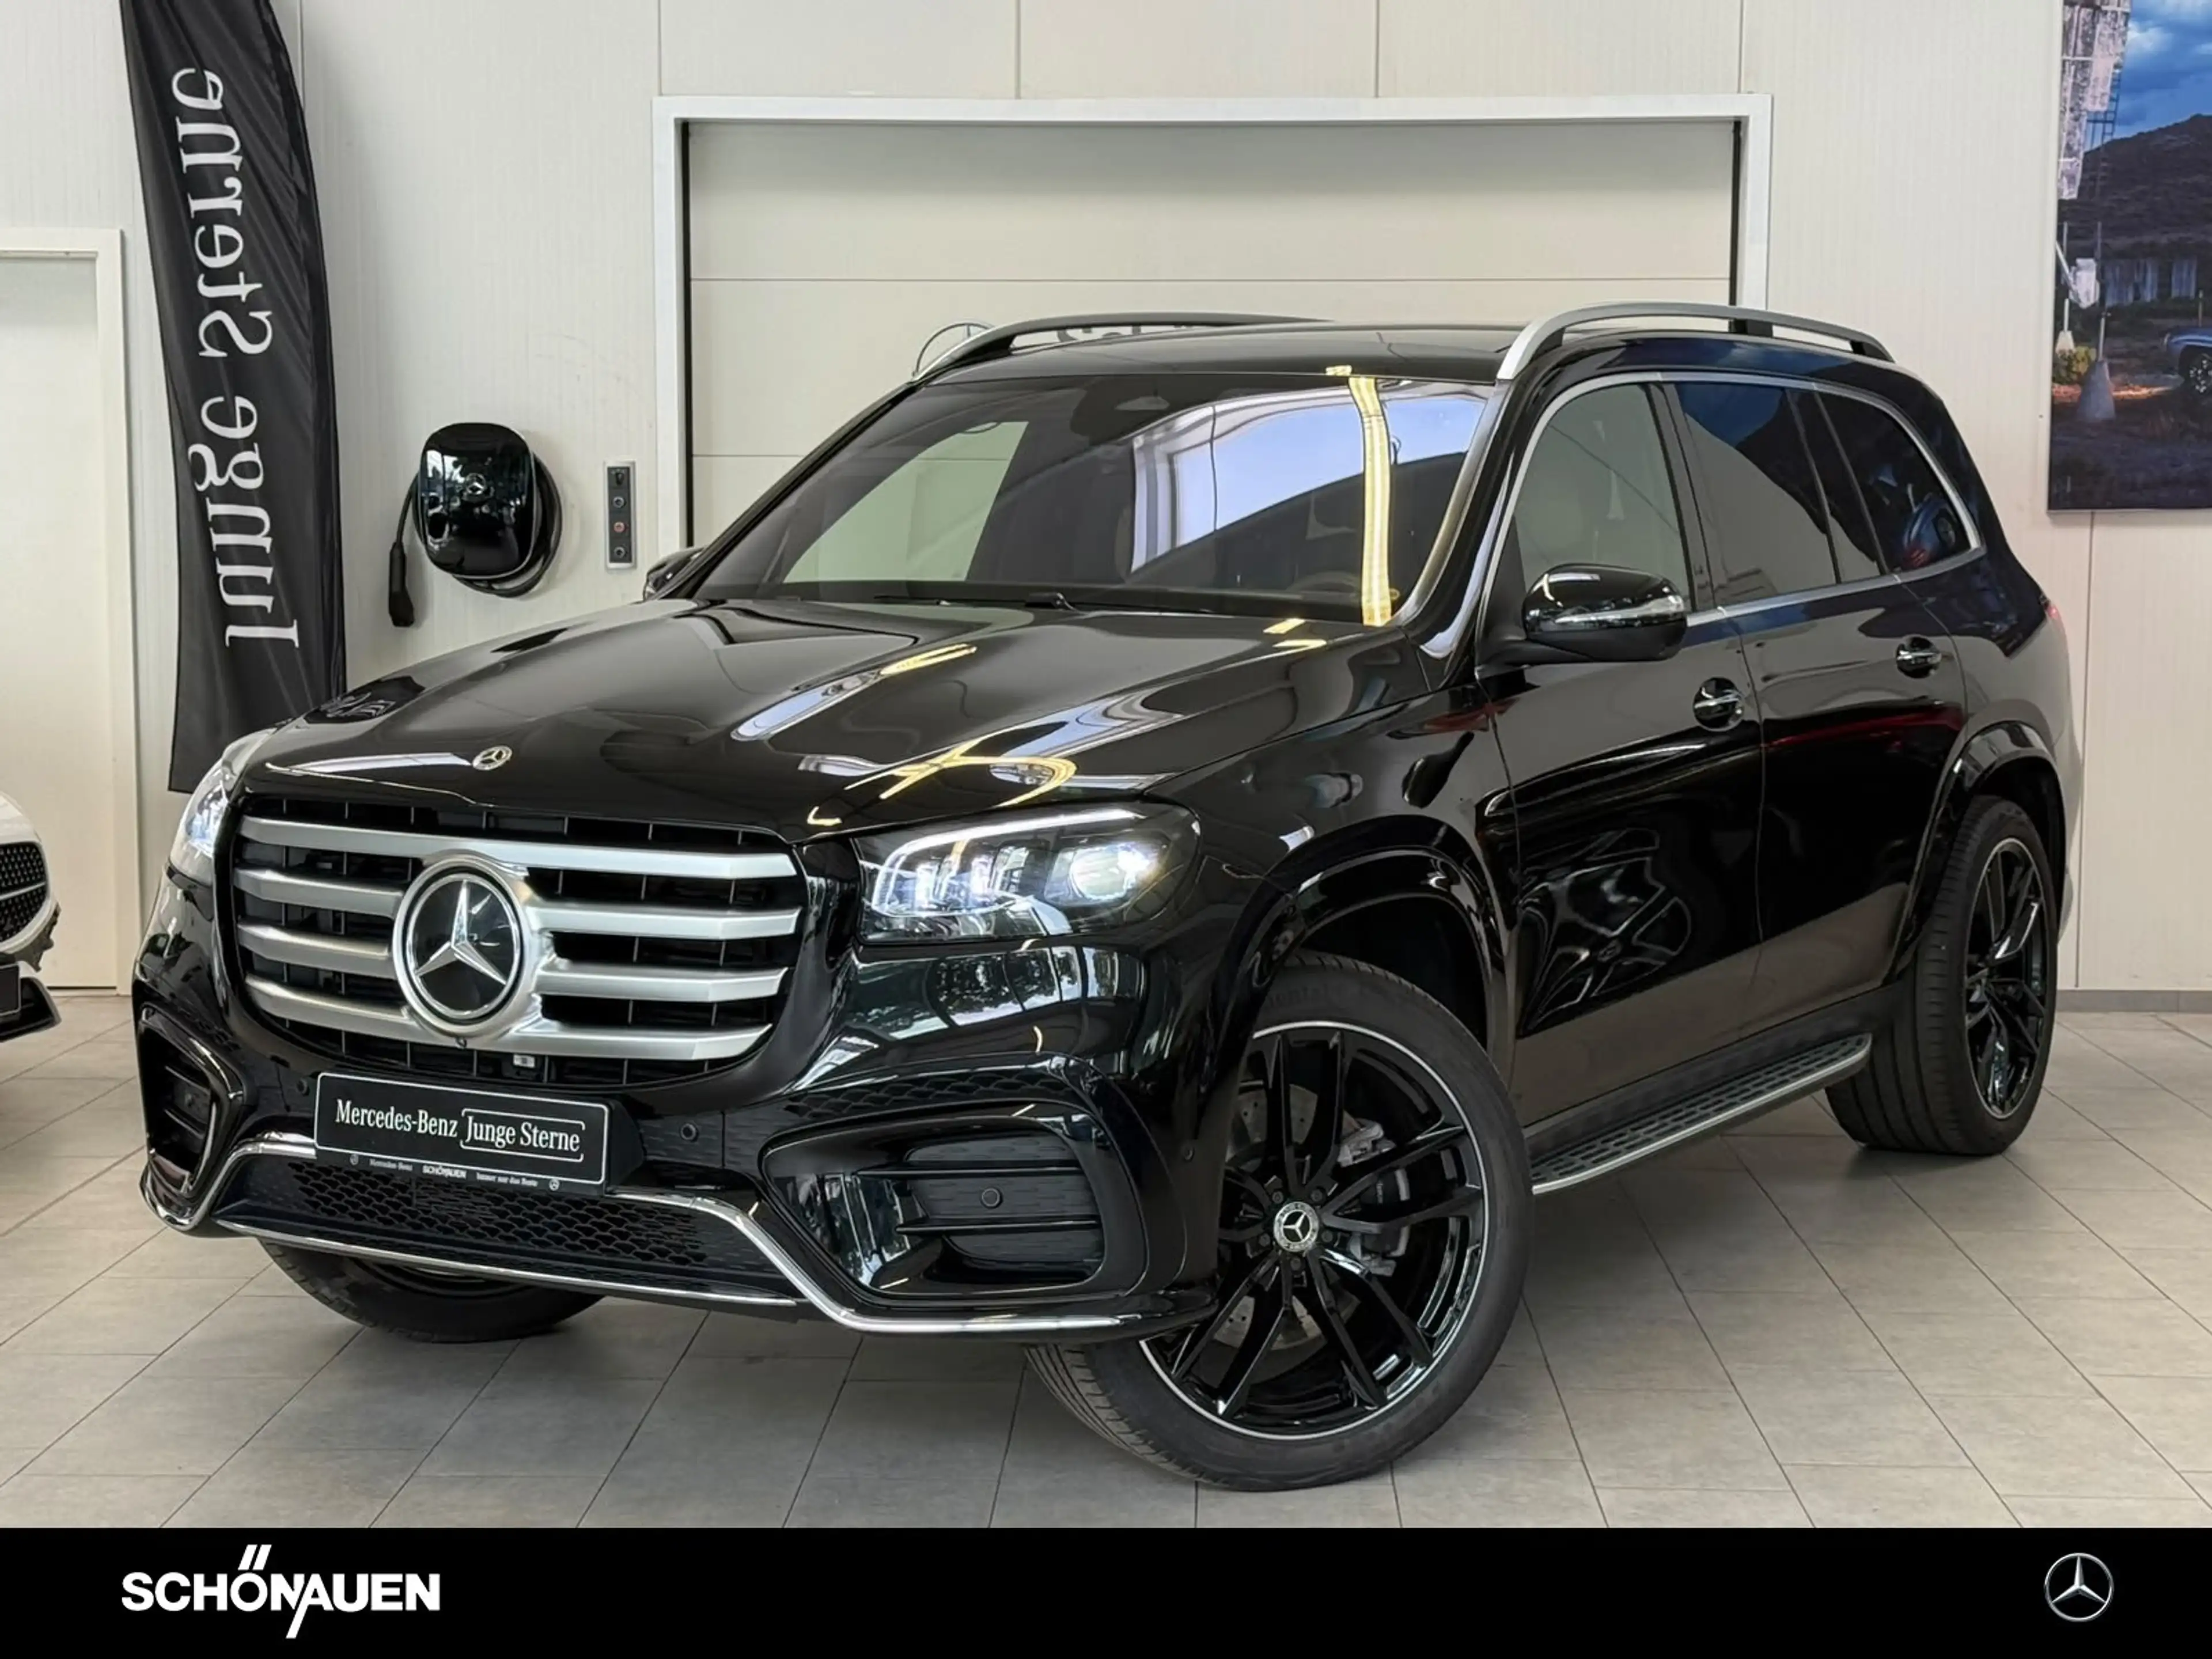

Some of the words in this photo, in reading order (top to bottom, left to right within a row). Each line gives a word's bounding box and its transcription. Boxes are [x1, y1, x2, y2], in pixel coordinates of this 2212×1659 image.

[335, 1099, 458, 1138] Mercedes-Benz
[464, 1115, 516, 1149] Junge
[520, 1122, 581, 1152] Sterne
